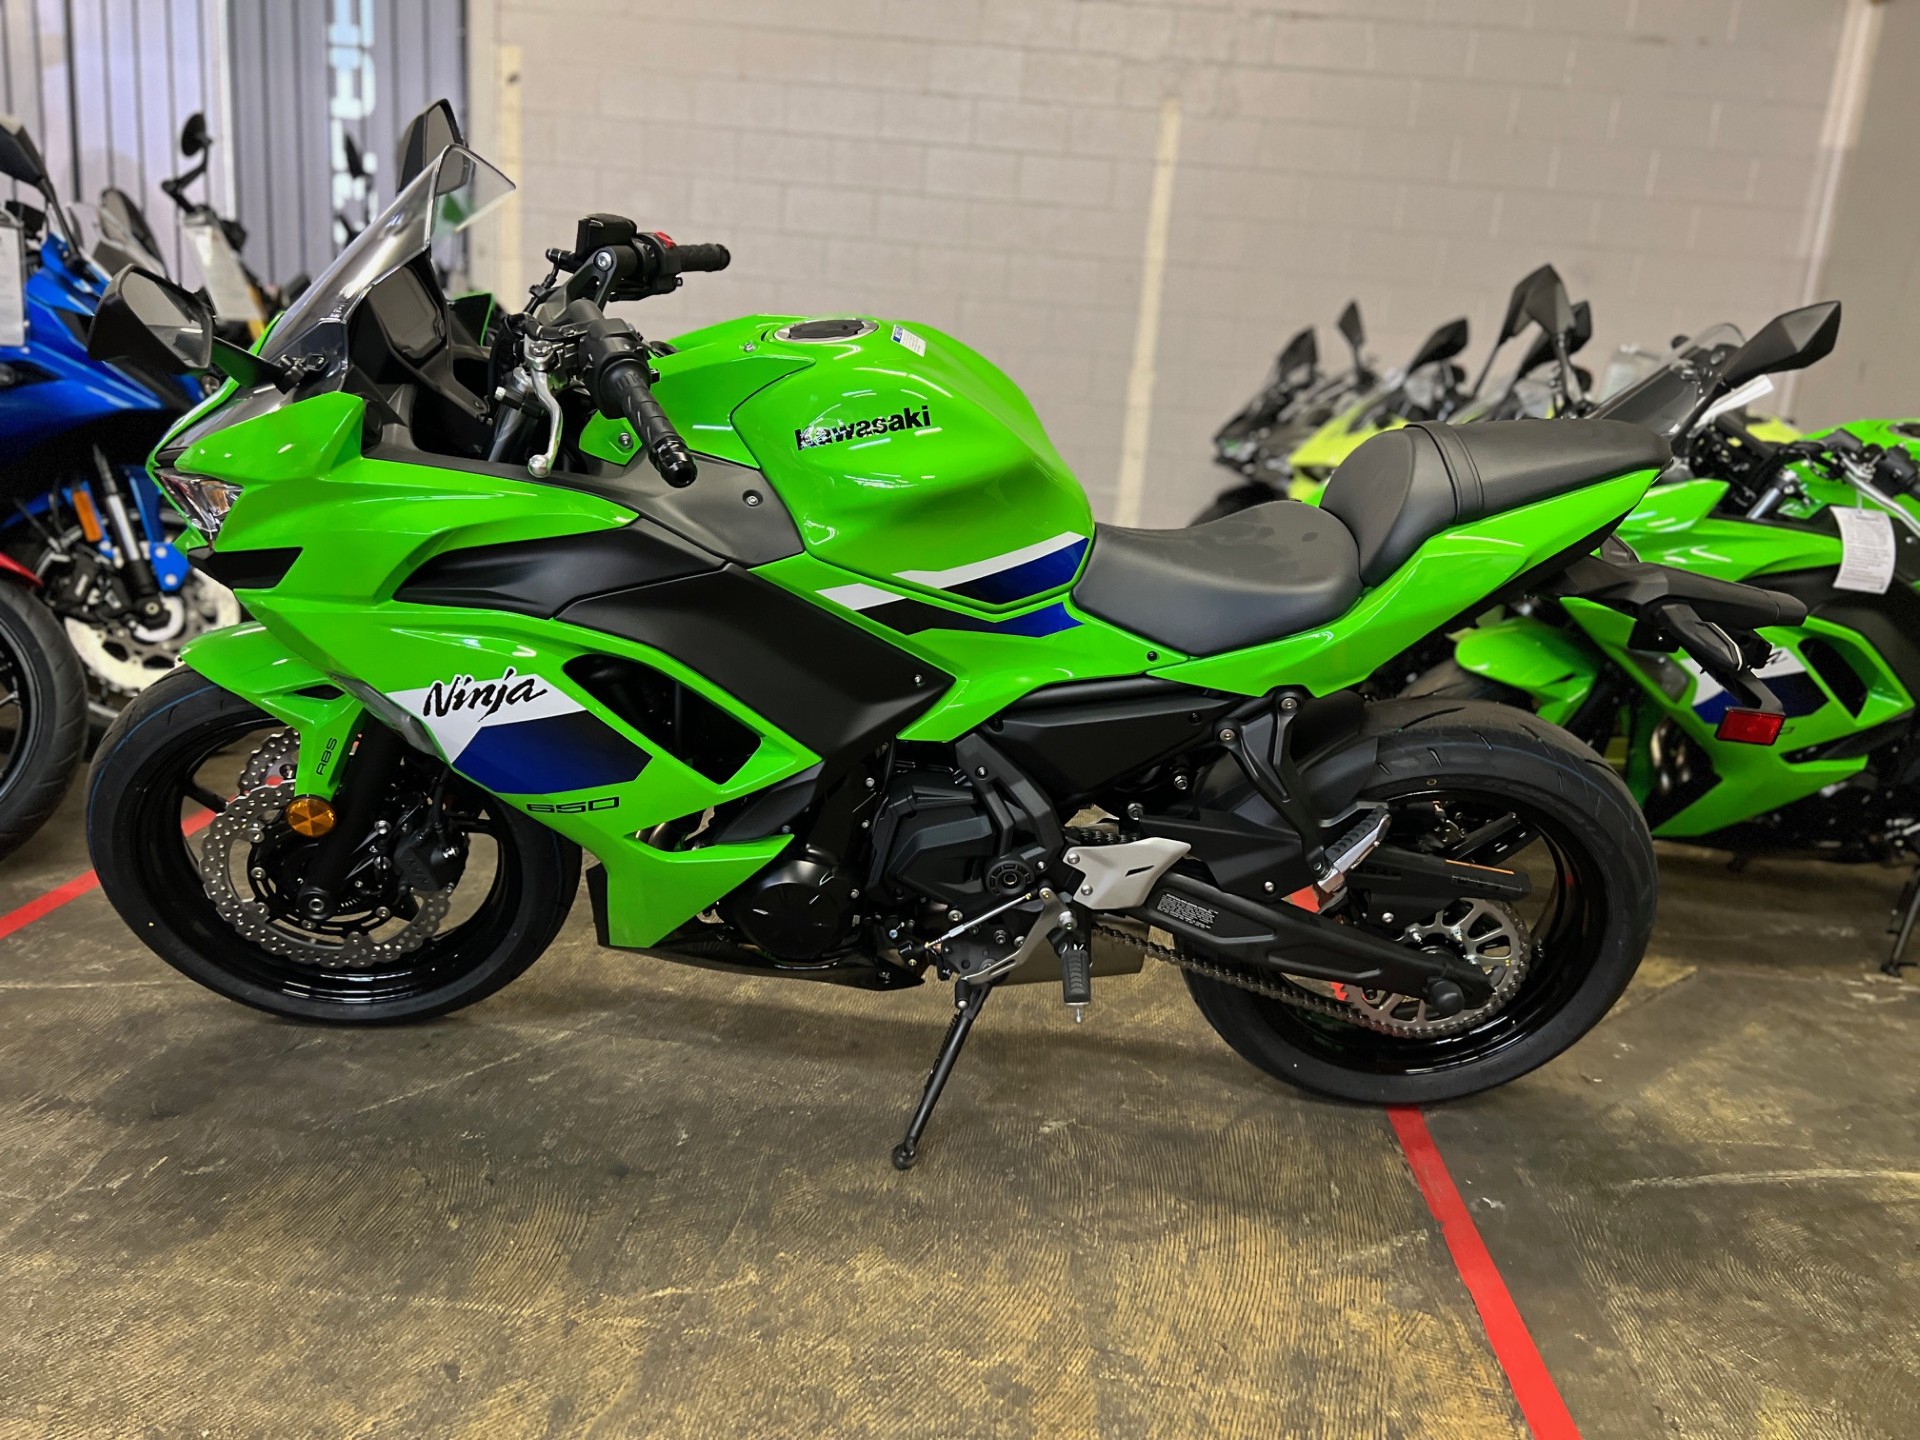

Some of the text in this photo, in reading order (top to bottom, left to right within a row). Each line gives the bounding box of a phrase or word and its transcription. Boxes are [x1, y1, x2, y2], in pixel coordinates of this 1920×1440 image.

[795, 405, 932, 451] Kawasaki
[423, 668, 548, 722] Ninja
[316, 737, 338, 776] ABS
[526, 796, 620, 814] 650
